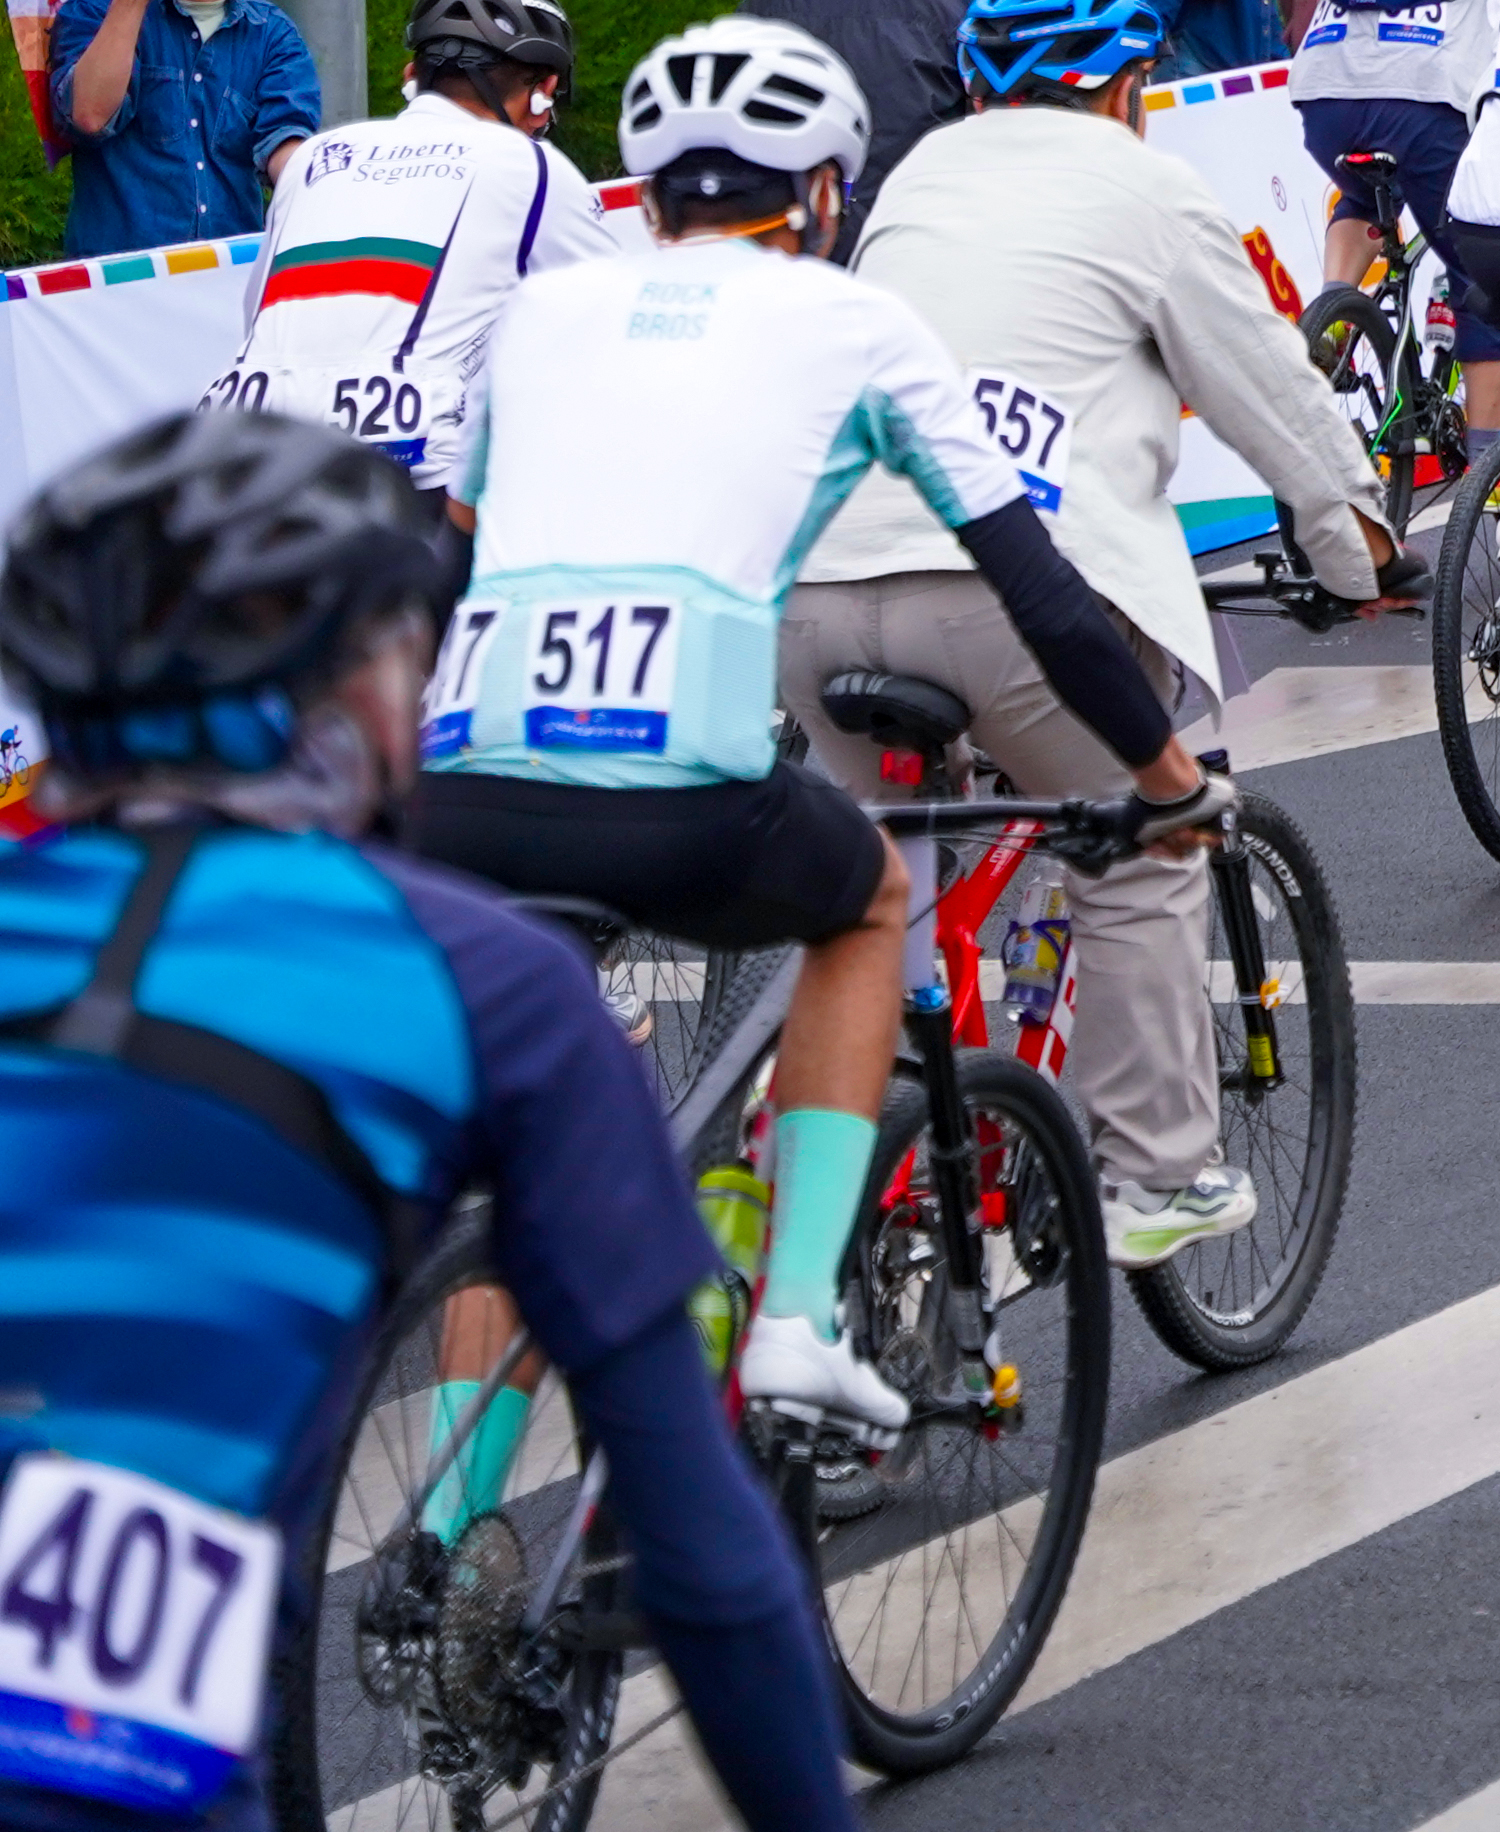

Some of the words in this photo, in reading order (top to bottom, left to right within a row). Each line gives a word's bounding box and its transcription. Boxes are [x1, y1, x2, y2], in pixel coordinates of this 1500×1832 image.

[352, 162, 467, 186] Seguros
[364, 141, 473, 165] Liberty
[636, 279, 720, 307] ROCK
[625, 312, 710, 341] BROS
[331, 374, 423, 439] 520
[974, 377, 1066, 472] 557
[536, 605, 672, 697] 517
[3, 1487, 248, 1714] 407
